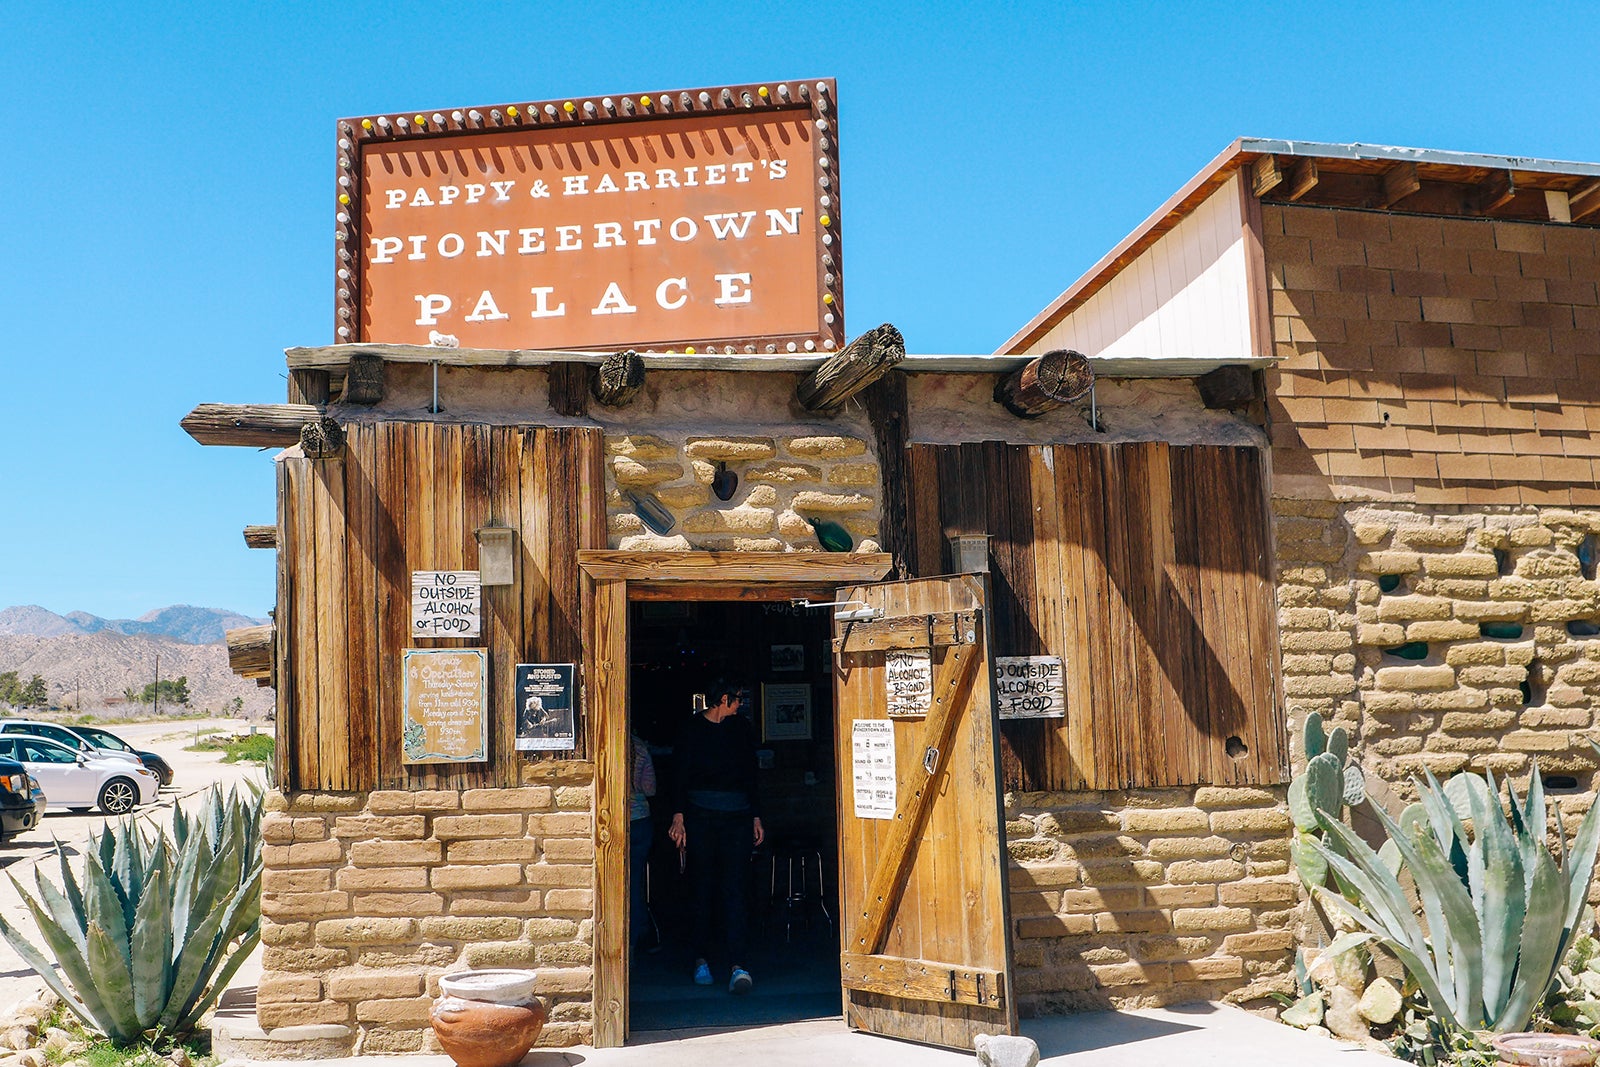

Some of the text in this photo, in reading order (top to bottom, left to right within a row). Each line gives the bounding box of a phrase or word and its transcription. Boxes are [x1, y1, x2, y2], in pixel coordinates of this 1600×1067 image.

[385, 159, 788, 209] PAPPY & HARRIET'S
[370, 207, 803, 264] PIONEERTOWN
[414, 272, 753, 326] PALACE
[435, 573, 457, 586] NO
[420, 587, 475, 600] OUTSIDE
[424, 601, 475, 615] ALCOHOL
[416, 617, 471, 634] or FOOD
[899, 653, 914, 668] NO
[888, 668, 926, 682] ALCOHOL
[1007, 662, 1059, 679] OUTSIDE
[893, 682, 925, 695] BEYOND
[893, 703, 923, 714] POINT
[1010, 696, 1053, 714] FOOD
